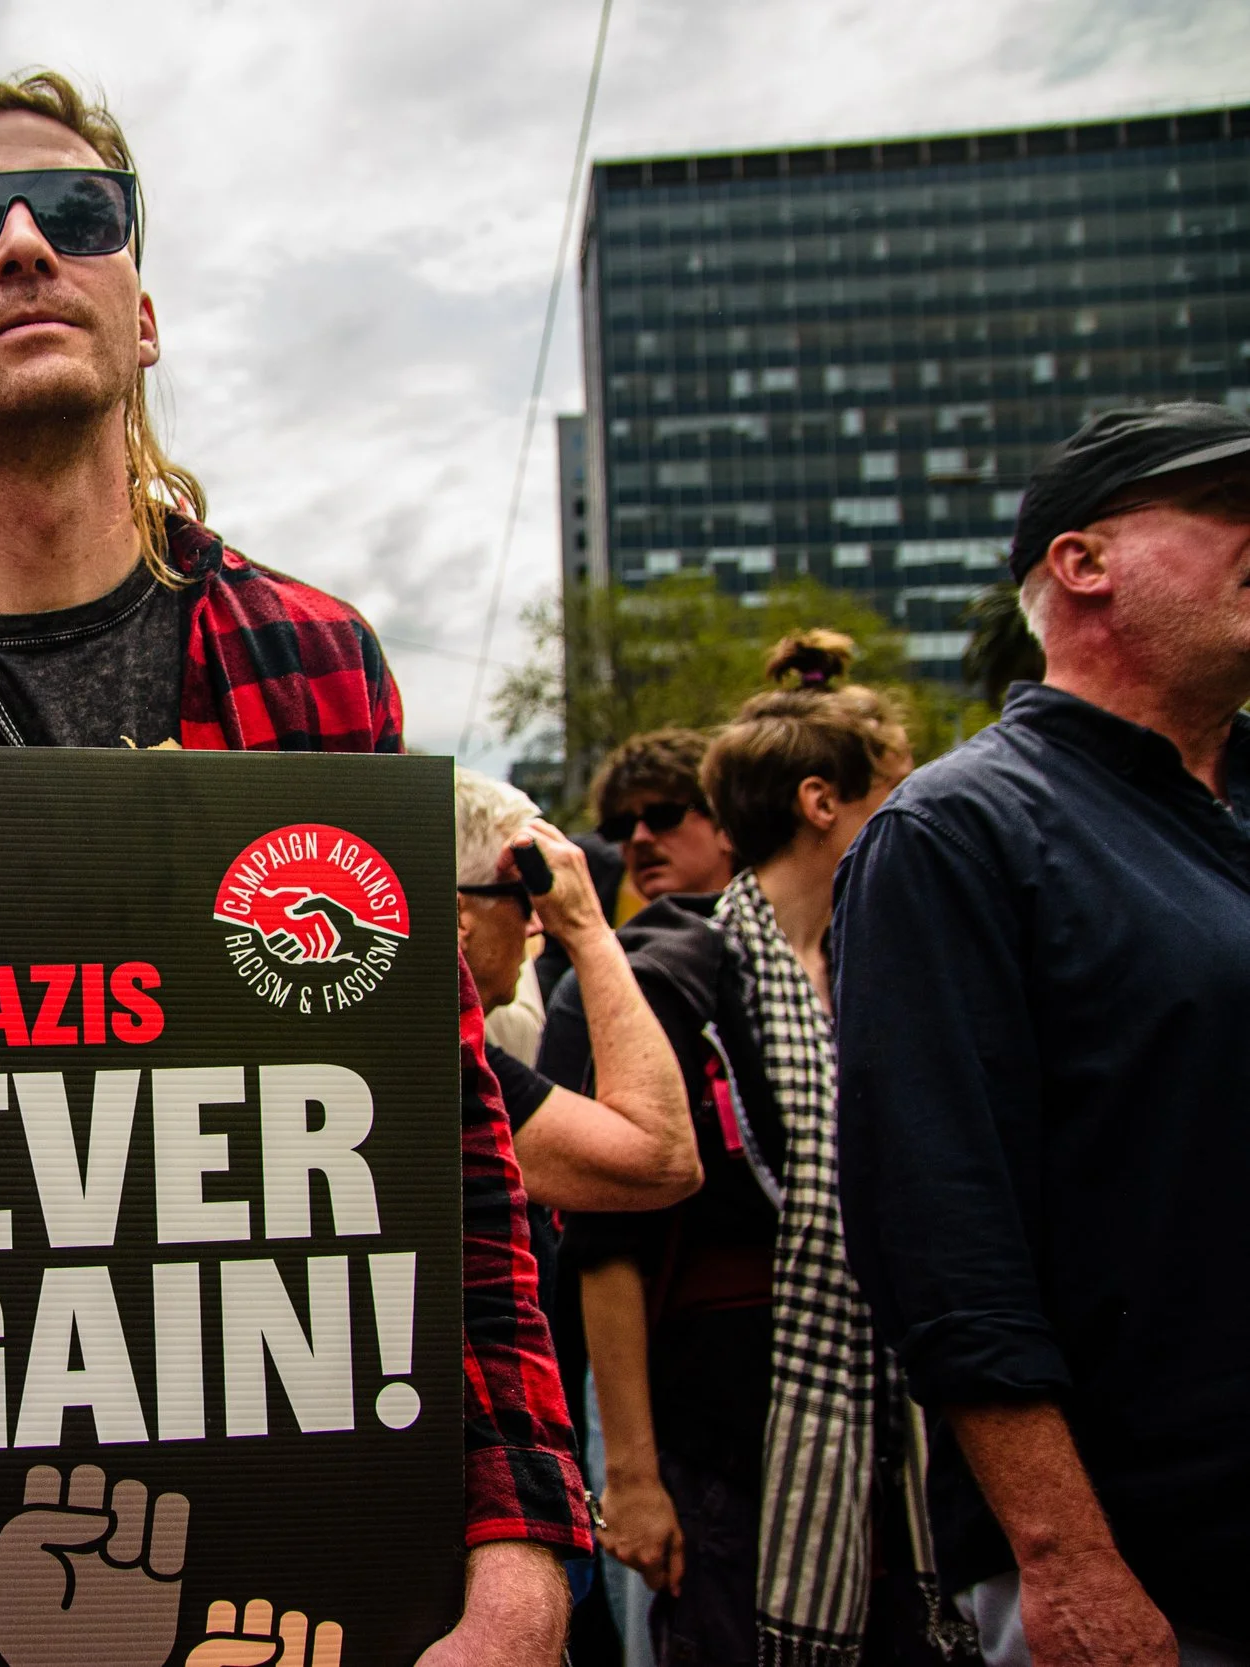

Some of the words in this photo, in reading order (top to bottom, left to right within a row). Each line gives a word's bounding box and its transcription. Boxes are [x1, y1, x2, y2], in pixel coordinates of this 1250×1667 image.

[223, 832, 318, 915] CAMPAIGN
[327, 838, 400, 923] AGAINST
[225, 933, 293, 1008] RACISM
[300, 986, 312, 1014] &
[323, 935, 399, 1013] FASCISM
